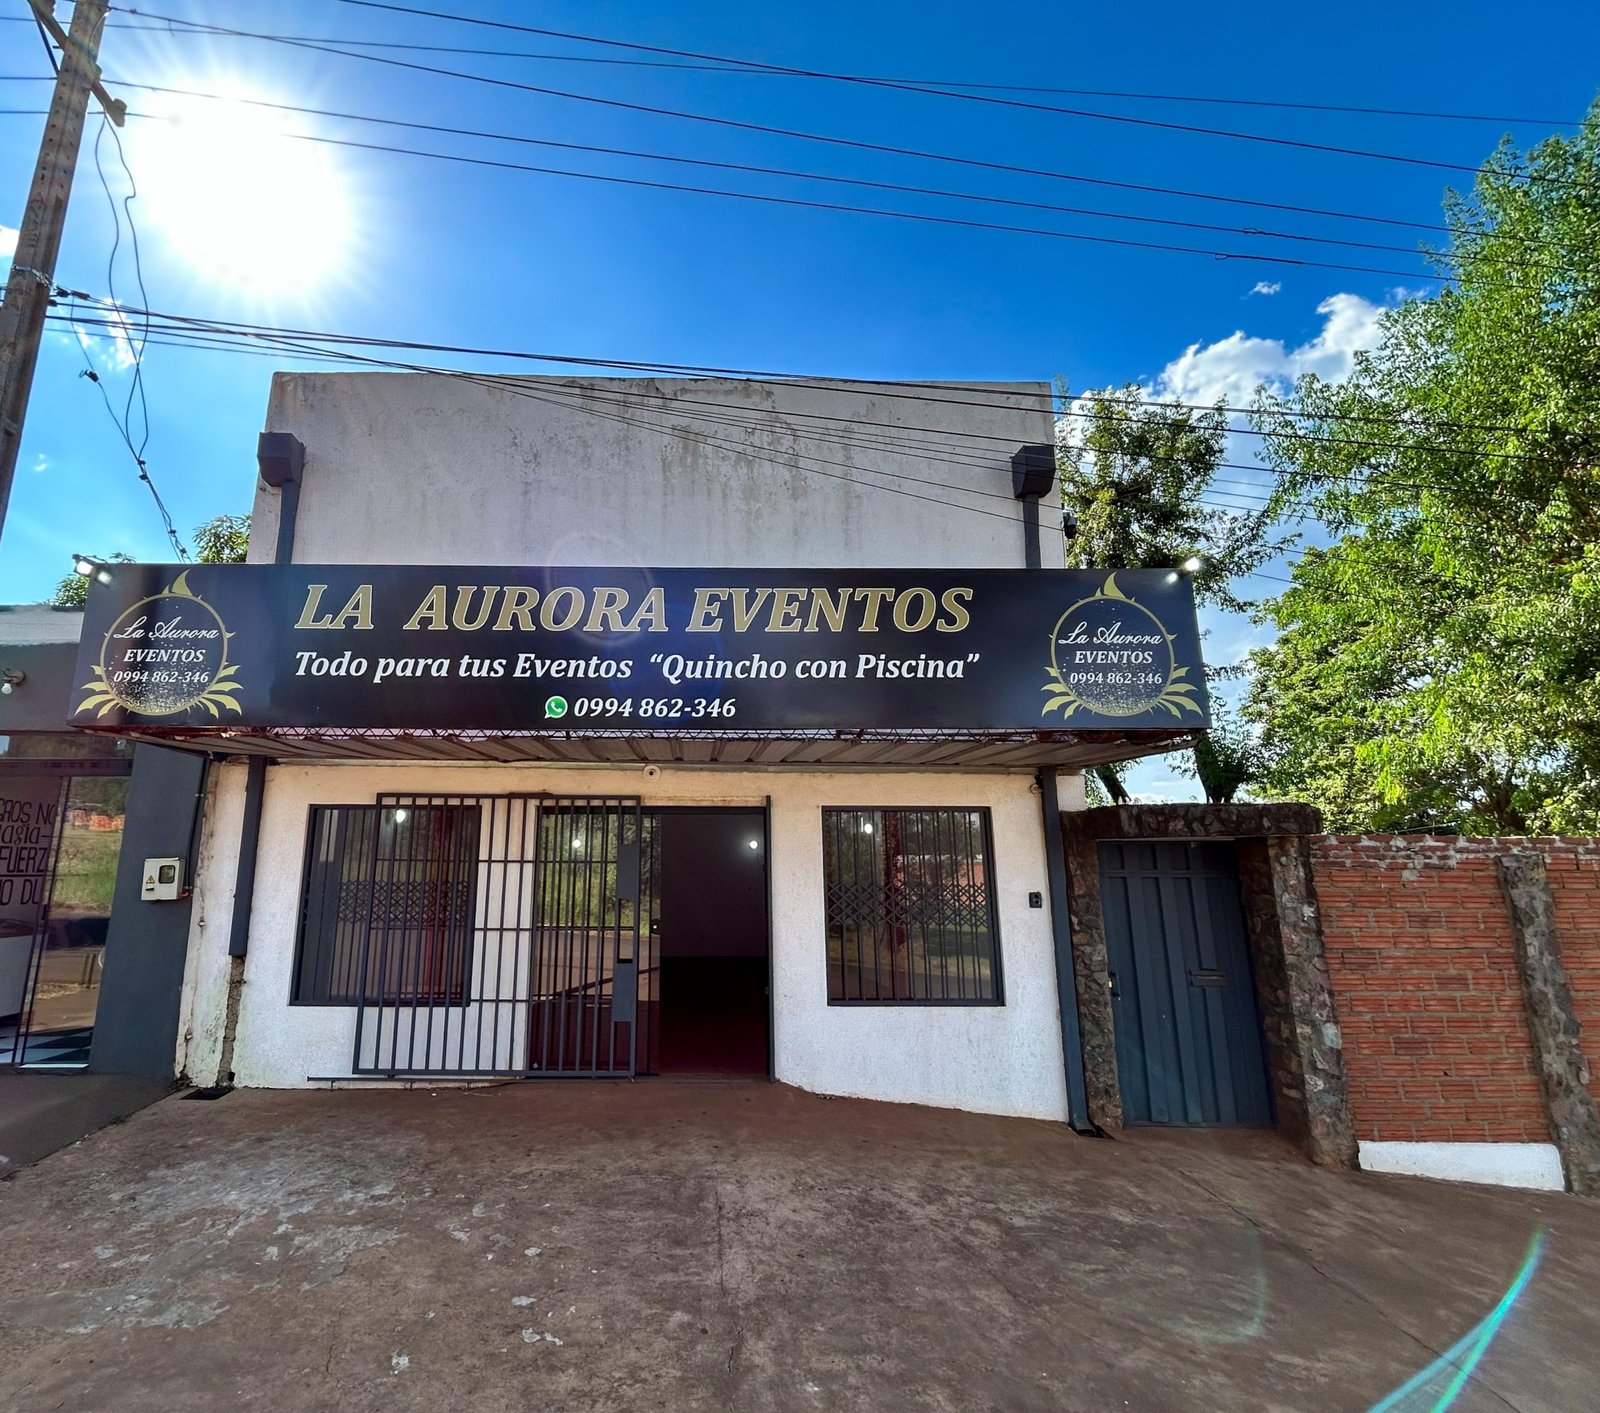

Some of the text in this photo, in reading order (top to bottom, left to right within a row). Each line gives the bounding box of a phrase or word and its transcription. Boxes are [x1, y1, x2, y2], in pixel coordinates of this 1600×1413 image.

[294, 584, 974, 633] LA AURORA EVENTOS
[113, 615, 220, 639] La Aurora
[1058, 621, 1163, 645] La Aurora
[123, 649, 206, 662] EVENTOS
[1074, 651, 1153, 664] EVENTOS
[113, 671, 209, 683] 0994 862-346
[294, 651, 980, 684] Todo para tus Eventos “Quincho con Piscina”
[1070, 672, 1162, 684] 0994 862-346
[574, 697, 736, 718] 0994 862-346
